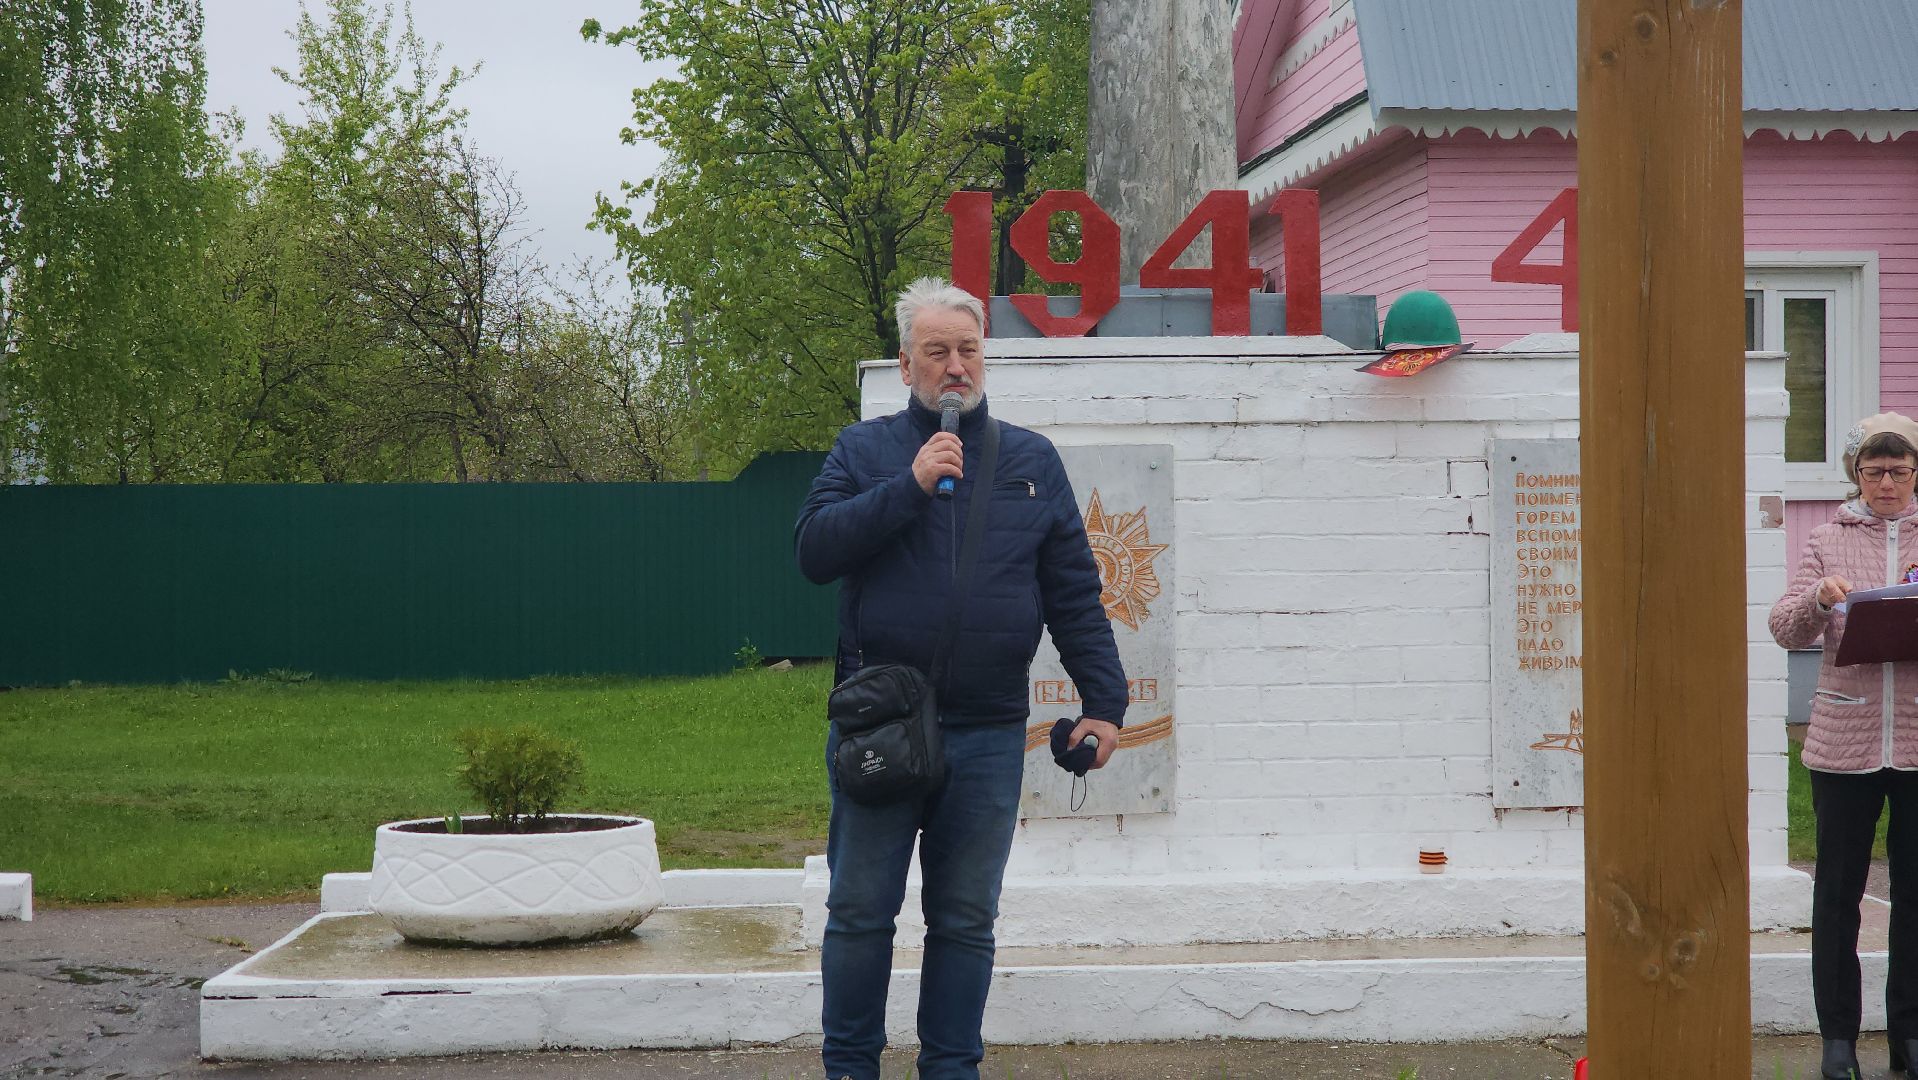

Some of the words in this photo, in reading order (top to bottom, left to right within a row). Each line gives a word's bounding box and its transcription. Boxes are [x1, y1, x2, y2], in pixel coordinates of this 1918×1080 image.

[942, 190, 1320, 337] 1941
[1491, 188, 1579, 332] 4
[1515, 493, 1581, 505] ПОИМЕ
[1516, 511, 1576, 525] ГОРЕМ
[1516, 529, 1581, 543] ВСПОМ
[1516, 547, 1578, 561] СВОИМ
[1518, 564, 1552, 578] ЭТО
[1518, 584, 1576, 597] НУЖНО
[1517, 602, 1537, 614] НЕ
[1547, 601, 1582, 614] МЕР
[1518, 619, 1552, 633] ЭТО
[1517, 638, 1563, 651] НАДО
[1519, 656, 1582, 670] ЖИВЫМ
[1127, 679, 1157, 702] 45
